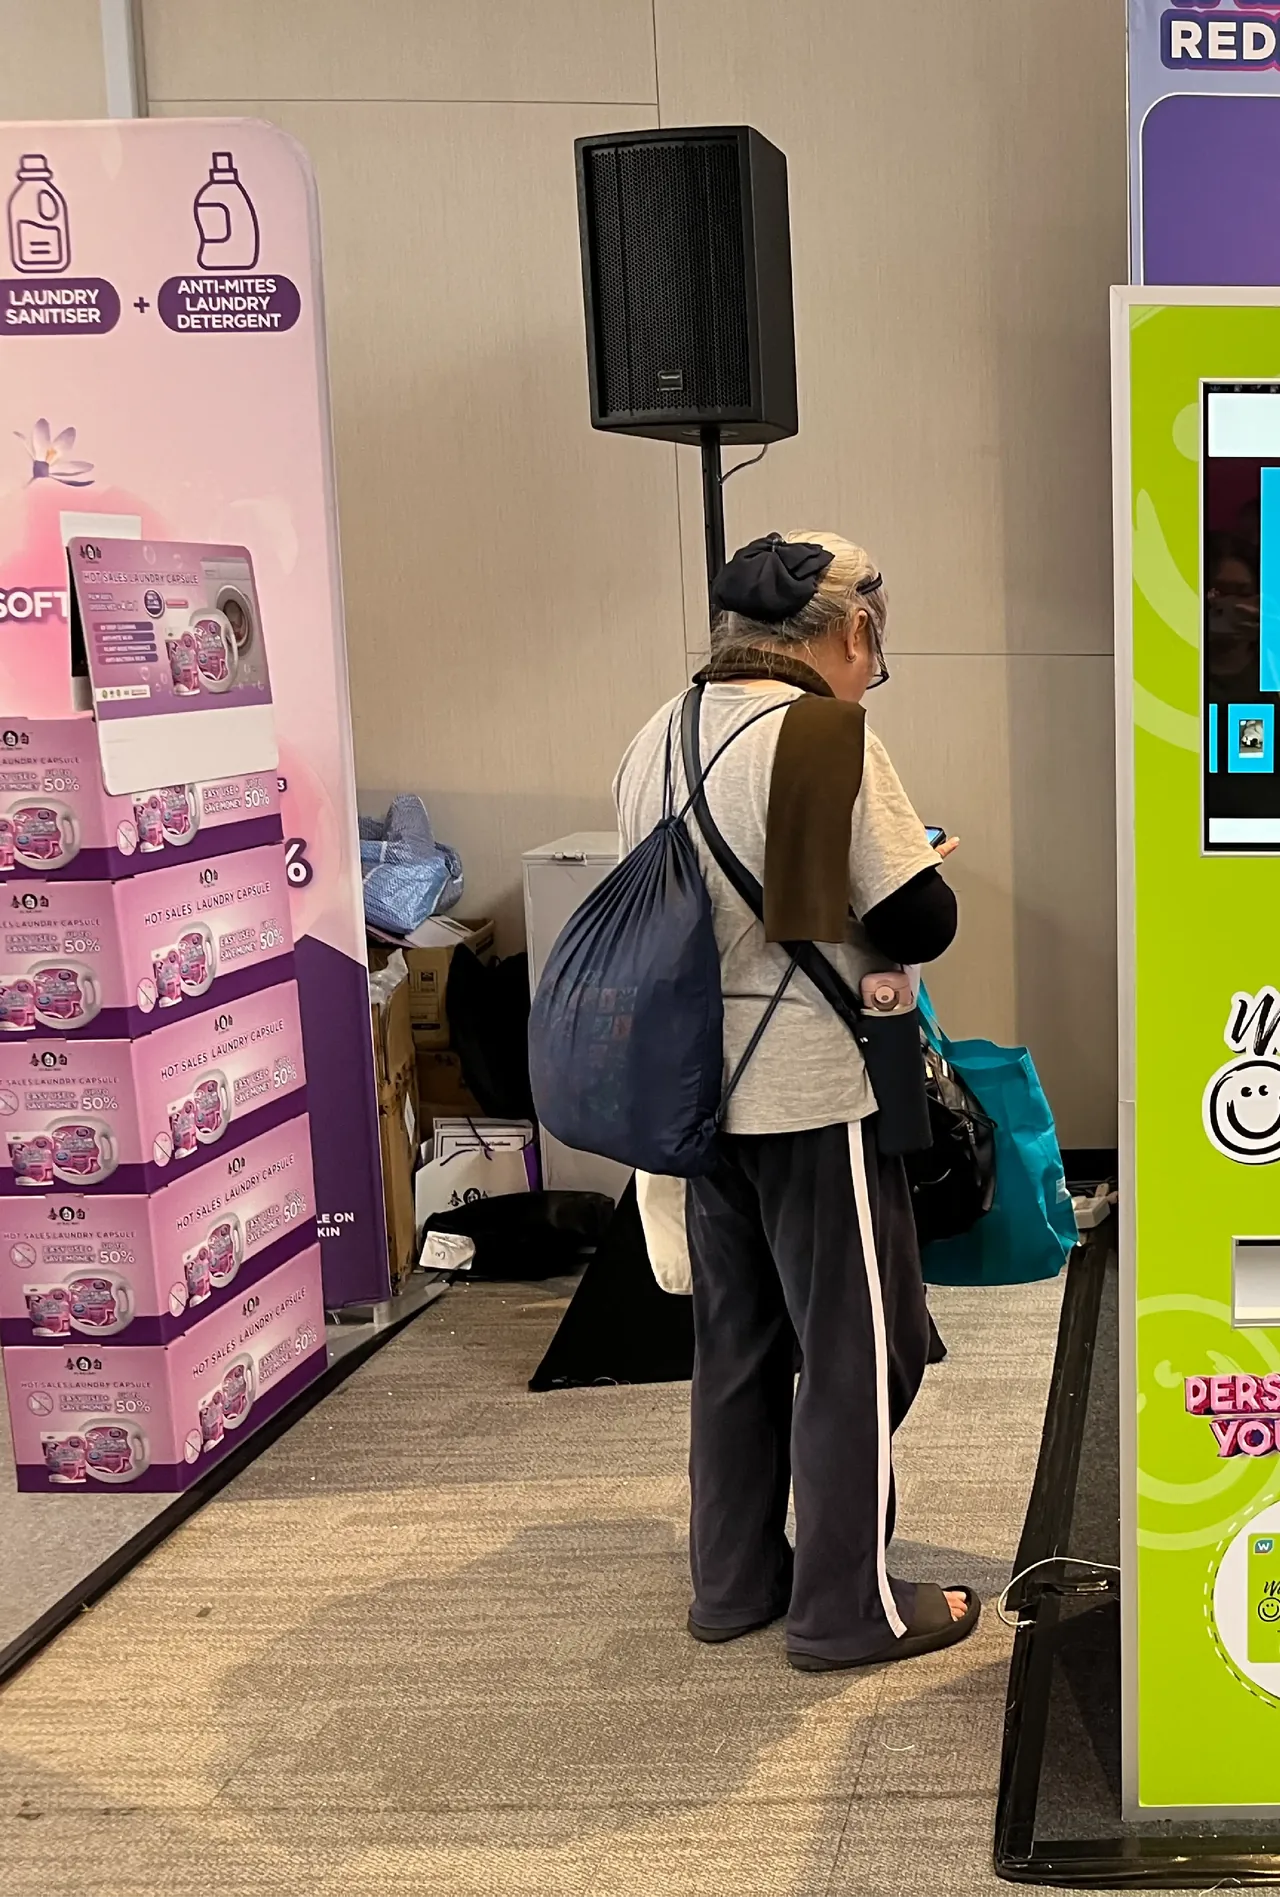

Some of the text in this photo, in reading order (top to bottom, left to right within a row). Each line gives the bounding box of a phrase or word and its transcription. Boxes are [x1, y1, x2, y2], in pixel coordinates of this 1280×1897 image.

[177, 279, 277, 294] ANTI-MITES
[9, 289, 100, 306] LAUNDRY
[186, 296, 271, 311] LAUNDRY
[5, 308, 101, 324] SANITISER
[177, 313, 282, 329] DETERGENT
[83, 572, 198, 584] HOT SALES LAUNDRY CAPSULE
[44, 778, 79, 791] 50%
[245, 789, 270, 808] 50%
[145, 882, 271, 925] HOT SALES LAUNDRY CAPSULE
[65, 939, 100, 953] 50%
[260, 928, 284, 951] 50%
[161, 1020, 283, 1079] HOT SALES LAUNDRY CAPSULE
[273, 1064, 296, 1088] 50%
[83, 1097, 118, 1110] 50%
[177, 1154, 294, 1230] HOT SALES LAUNDRY CAPSULE
[283, 1196, 306, 1222] 50%
[333, 1212, 355, 1223] ON
[317, 1226, 340, 1238] KIN
[100, 1250, 135, 1263] 50%
[193, 1360, 209, 1377] HOT
[211, 1340, 236, 1364] SALES
[240, 1311, 273, 1342] LAUNDRY
[276, 1287, 306, 1316] CAPSULE
[116, 1400, 151, 1413] 50%
